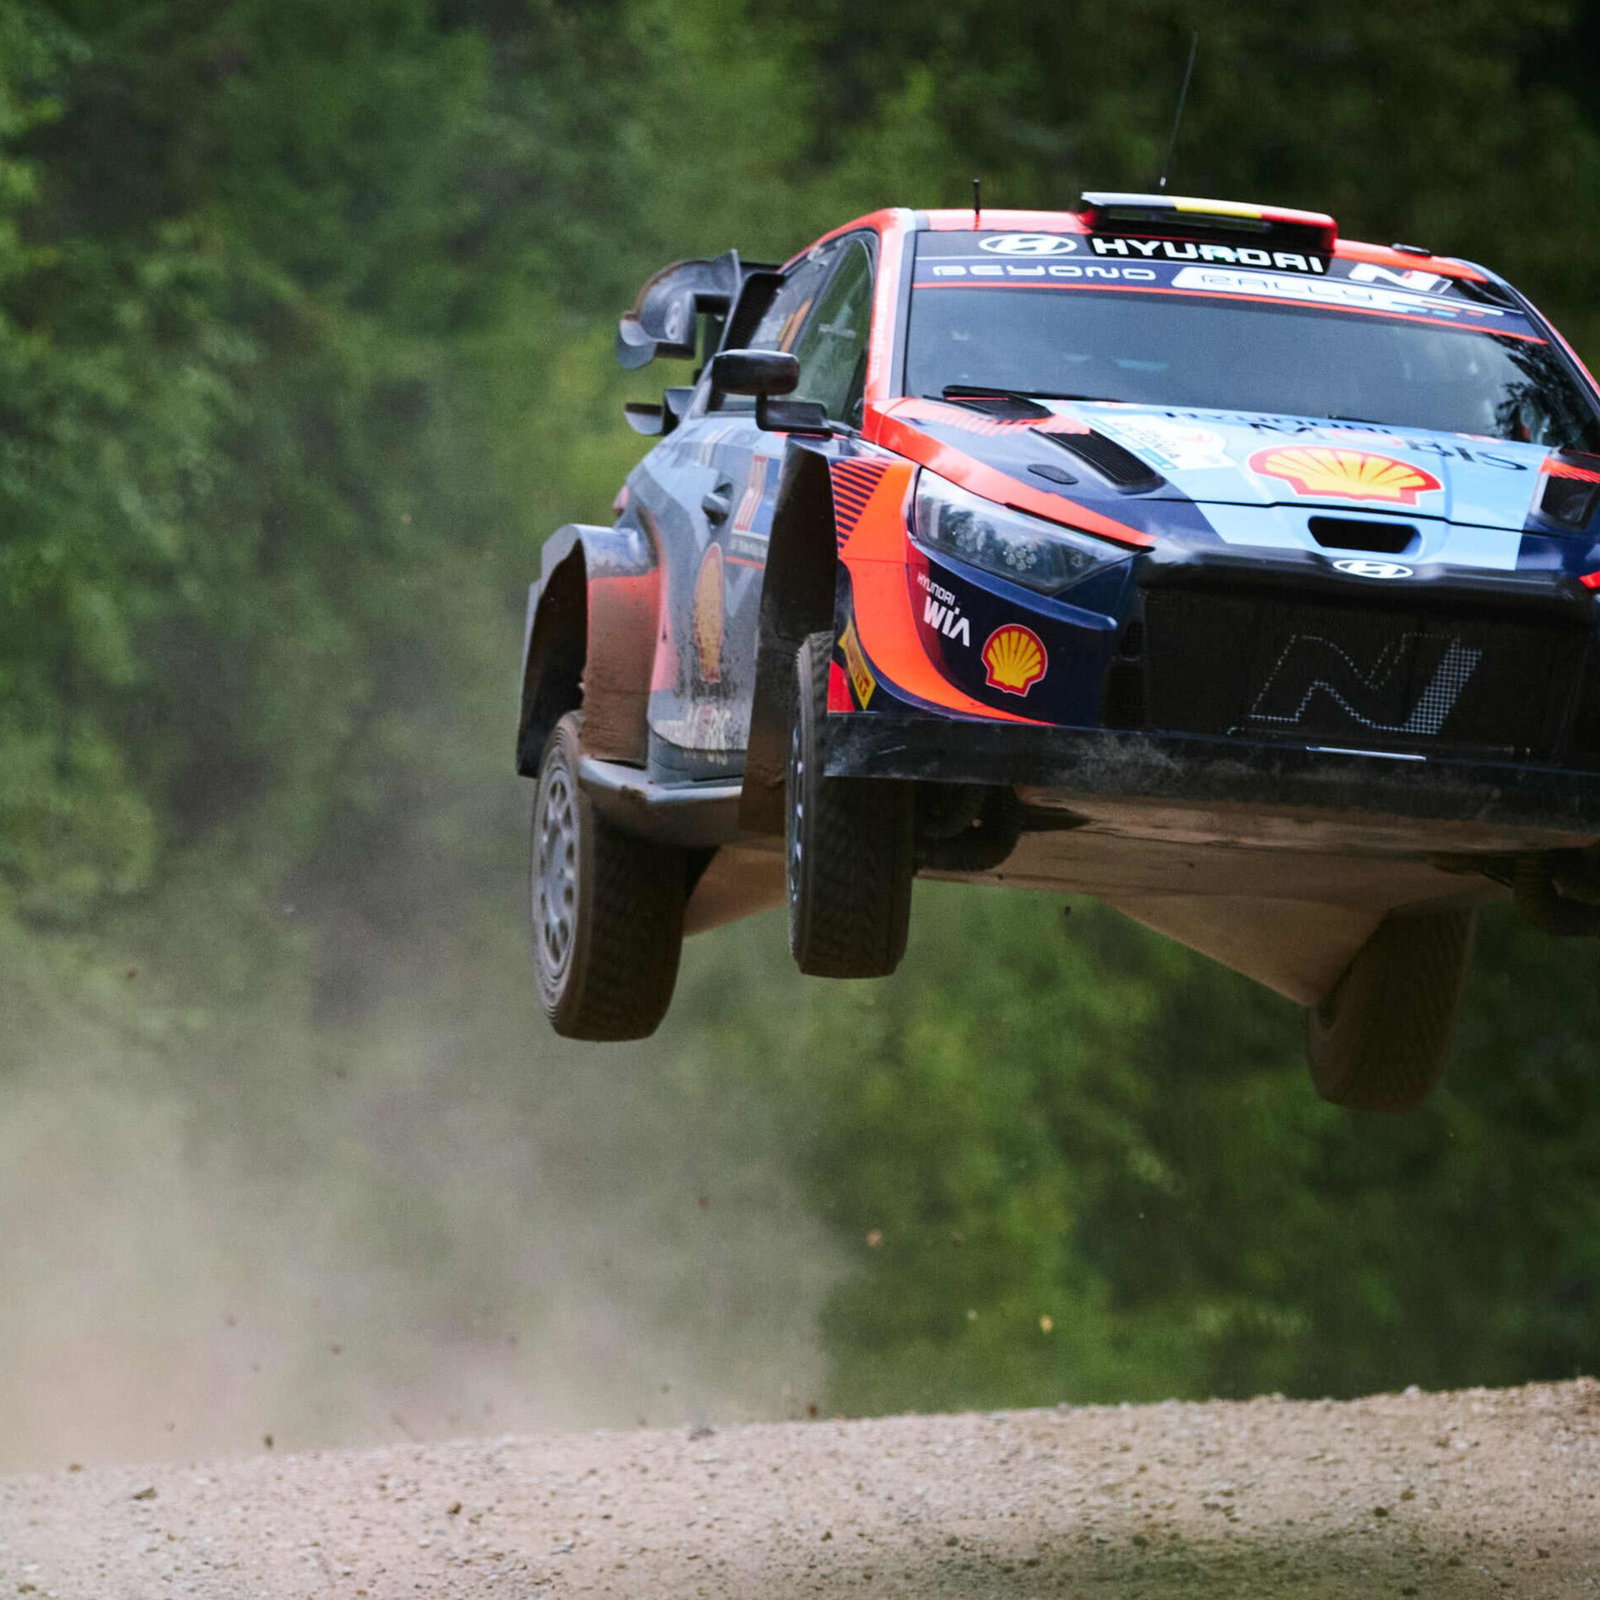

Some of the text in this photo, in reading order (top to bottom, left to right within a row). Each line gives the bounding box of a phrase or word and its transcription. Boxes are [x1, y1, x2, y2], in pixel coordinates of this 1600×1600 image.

[932, 264, 1156, 281] BEYOND
[1092, 237, 1324, 273] HYUNDAI
[917, 571, 956, 606] HYUNDAI
